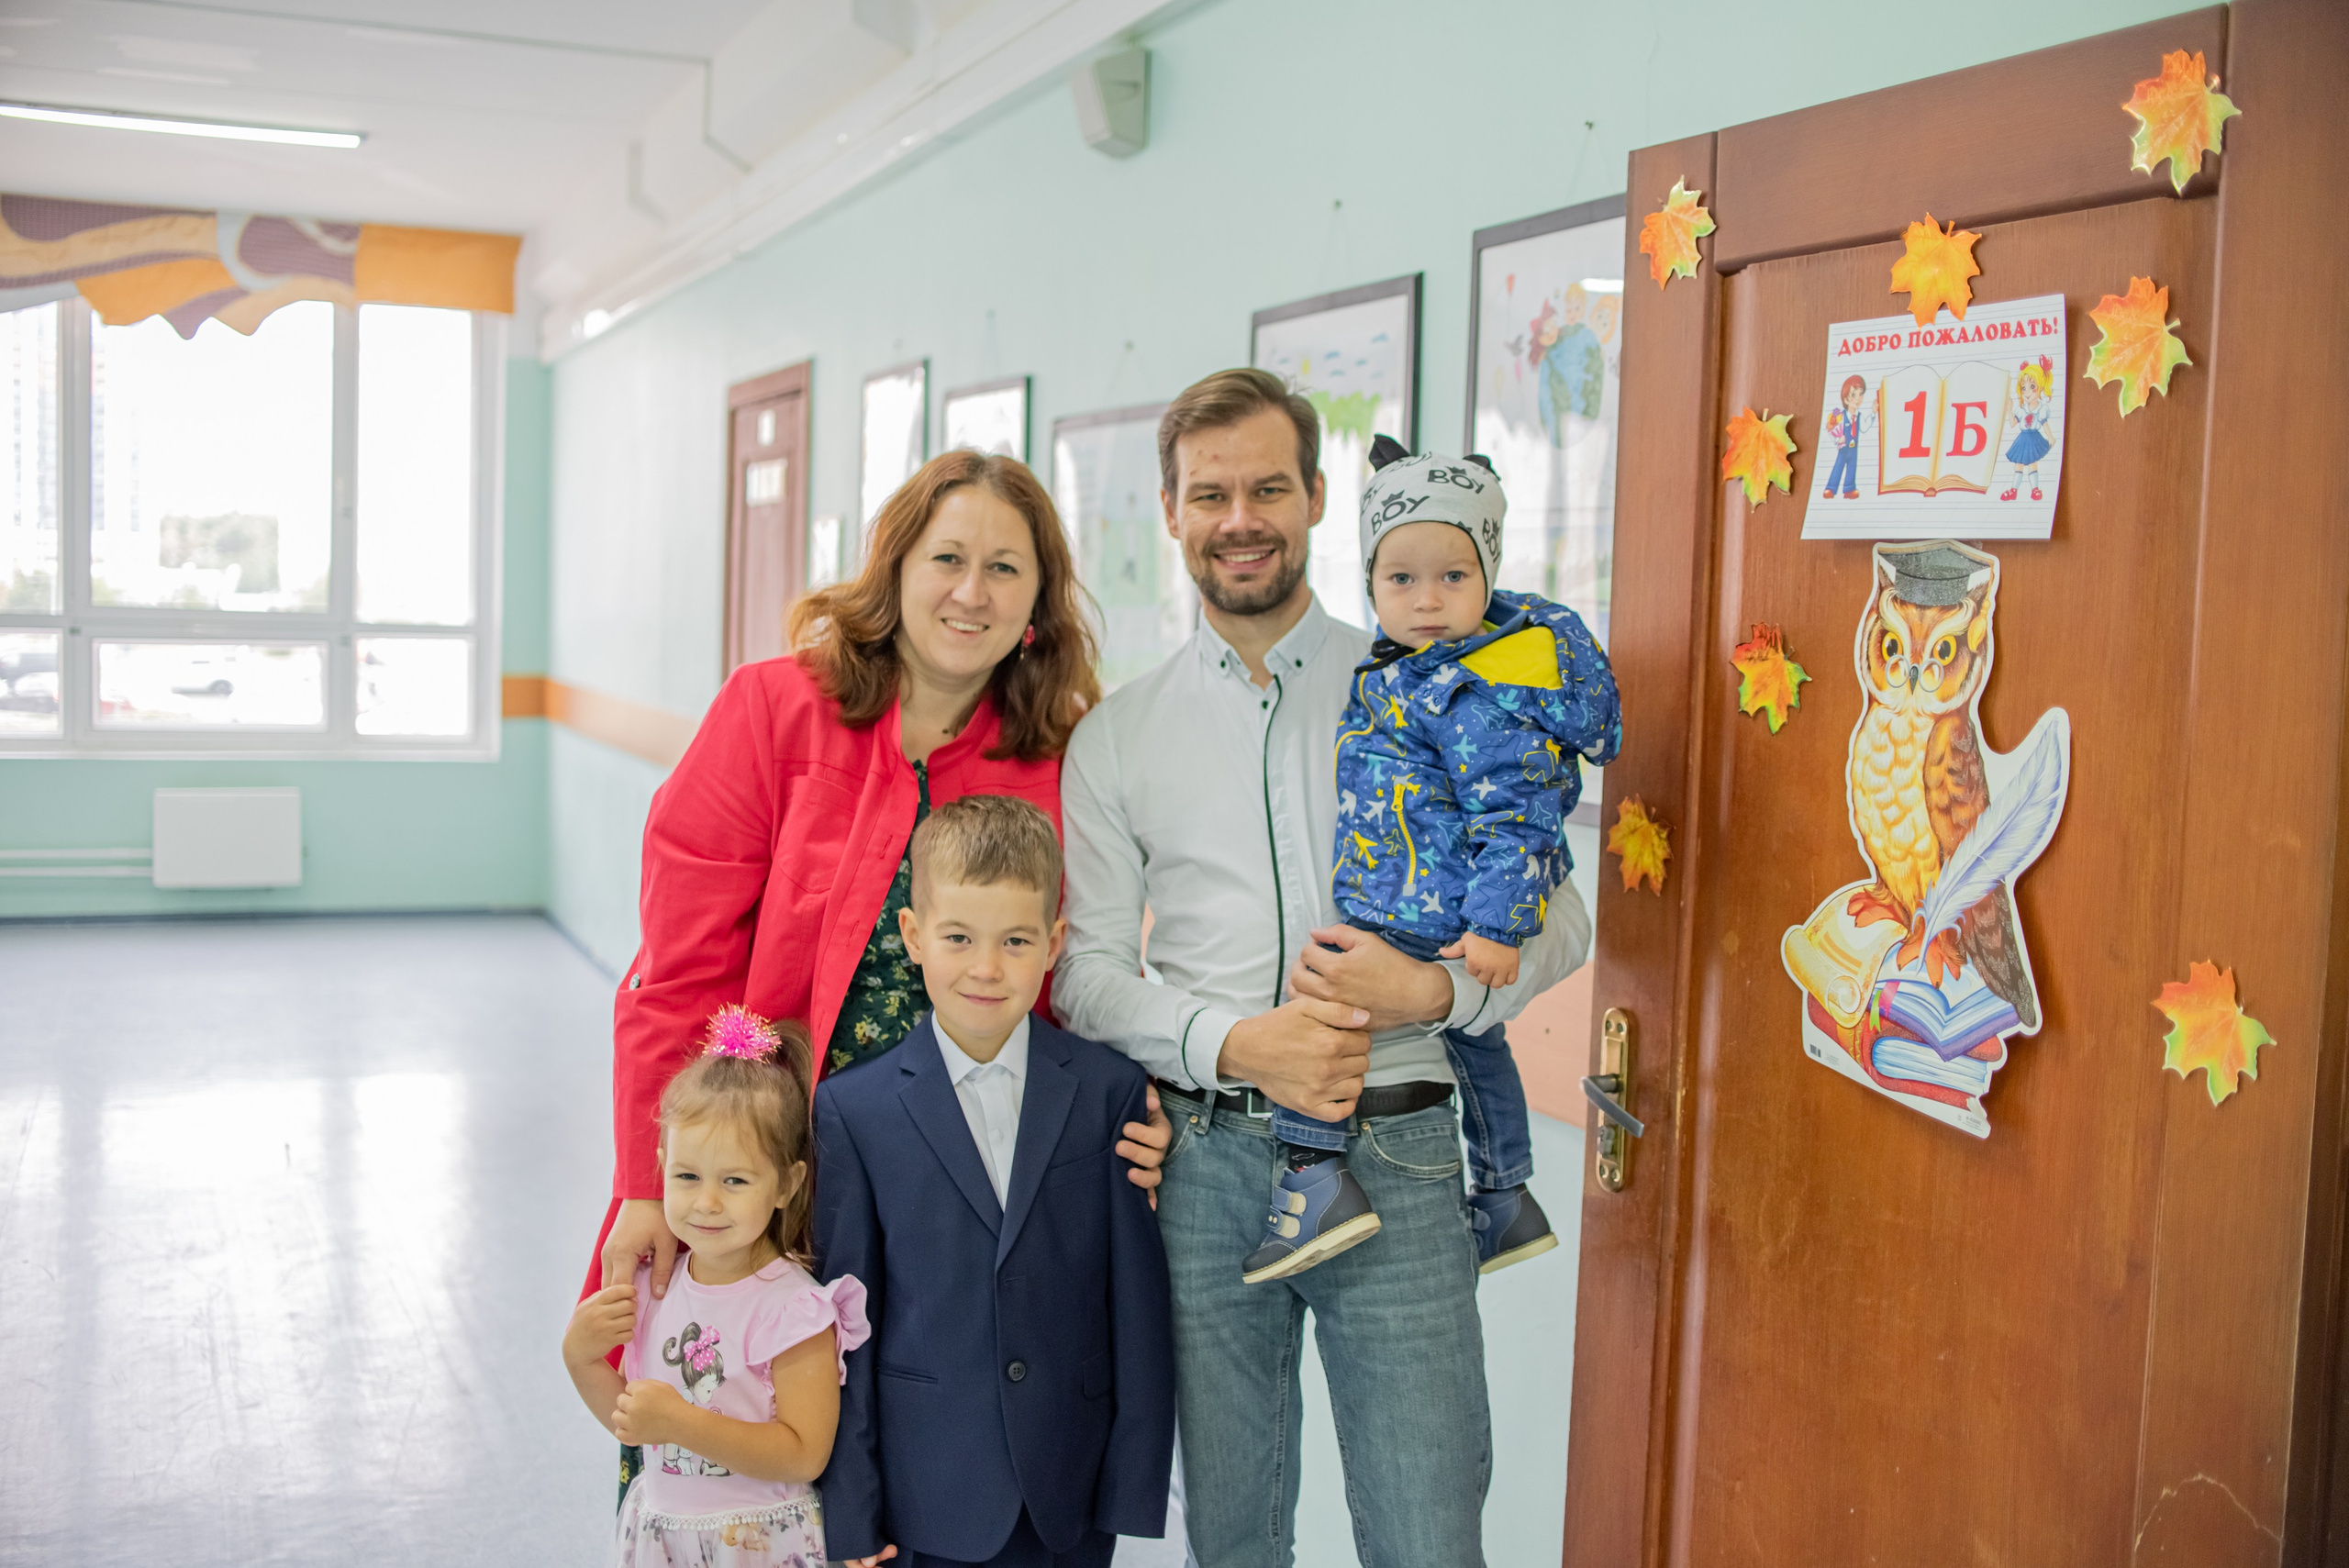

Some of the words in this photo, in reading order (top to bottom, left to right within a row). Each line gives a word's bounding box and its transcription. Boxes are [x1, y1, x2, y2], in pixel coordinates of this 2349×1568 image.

[1838, 333, 1901, 357] ДОБРО
[1908, 317, 2058, 348] ПОЖАЛОВАТЬ!
[1898, 391, 1931, 458] 1
[1945, 401, 1987, 457] Б
[1427, 469, 1485, 495] BOY
[1371, 495, 1431, 537] BOY
